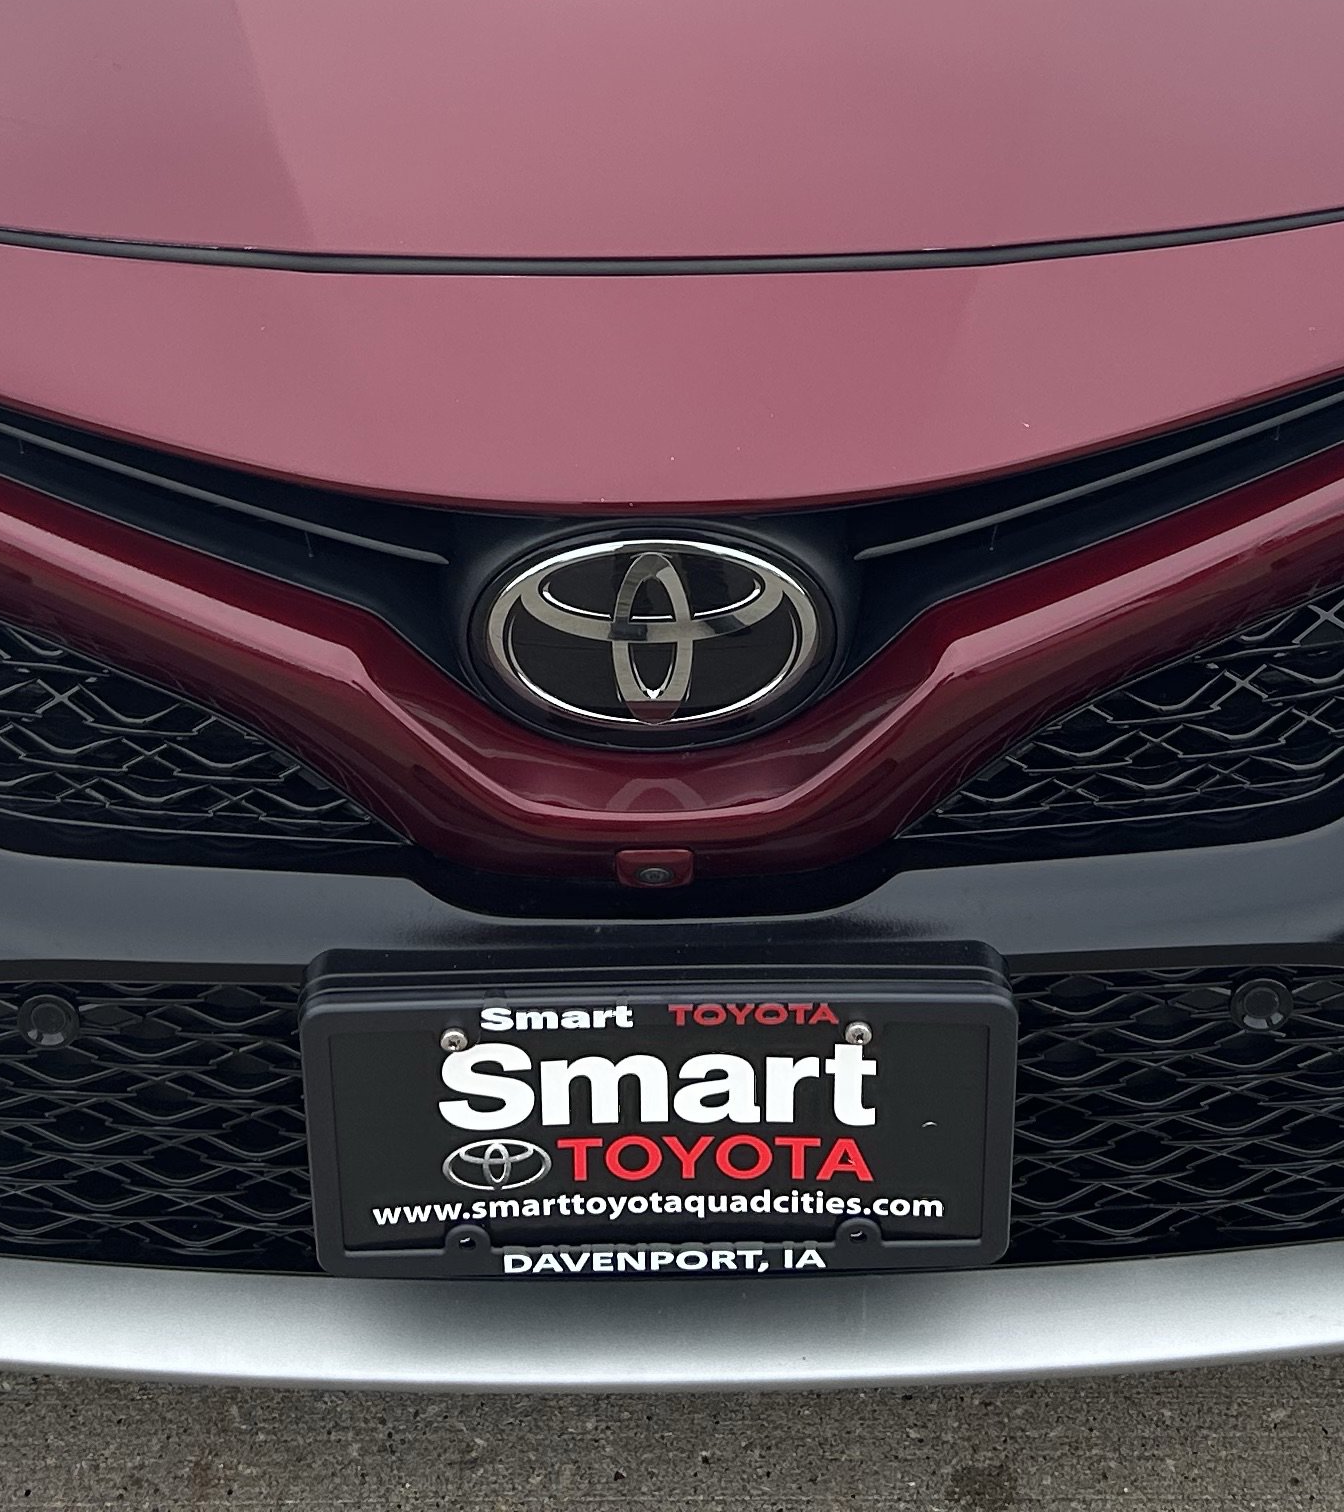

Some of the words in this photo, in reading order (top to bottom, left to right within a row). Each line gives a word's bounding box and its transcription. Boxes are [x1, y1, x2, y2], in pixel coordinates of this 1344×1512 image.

[480, 1004, 634, 1031] Smart
[668, 1003, 840, 1027] TOYOTA
[438, 1042, 877, 1131] Smart
[558, 1135, 874, 1183] TOYOTA
[372, 1188, 945, 1226] www.smarttoyotaquadcities.com
[503, 1249, 770, 1275] DAVENPORT,
[784, 1248, 826, 1270] IA
